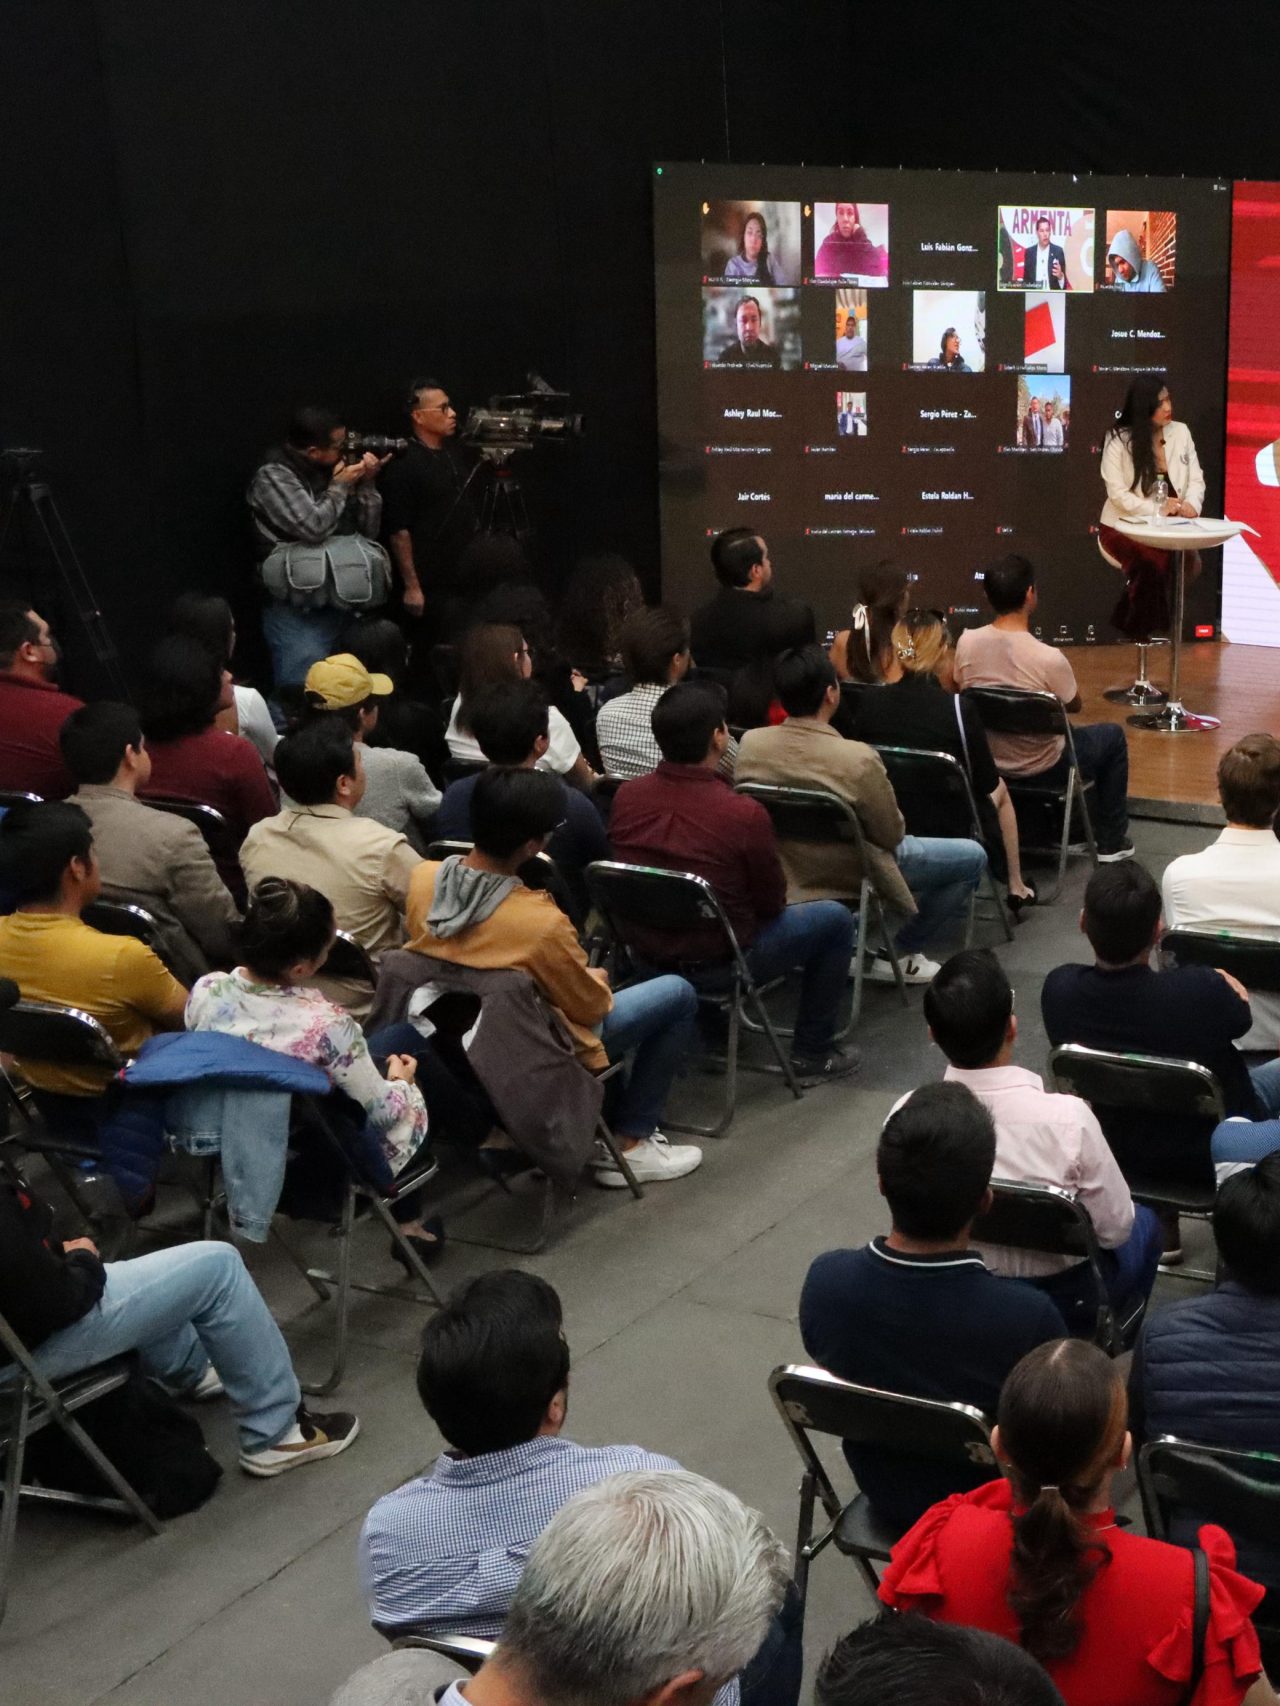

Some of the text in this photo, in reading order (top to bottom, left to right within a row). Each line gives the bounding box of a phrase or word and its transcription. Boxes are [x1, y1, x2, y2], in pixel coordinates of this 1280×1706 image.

[1012, 209, 1072, 237] ARMNTA
[921, 243, 933, 251] Luis
[724, 409, 744, 419] Ashley
[920, 410, 939, 420] Sergio
[738, 492, 749, 501] Jair
[844, 492, 853, 500] del
